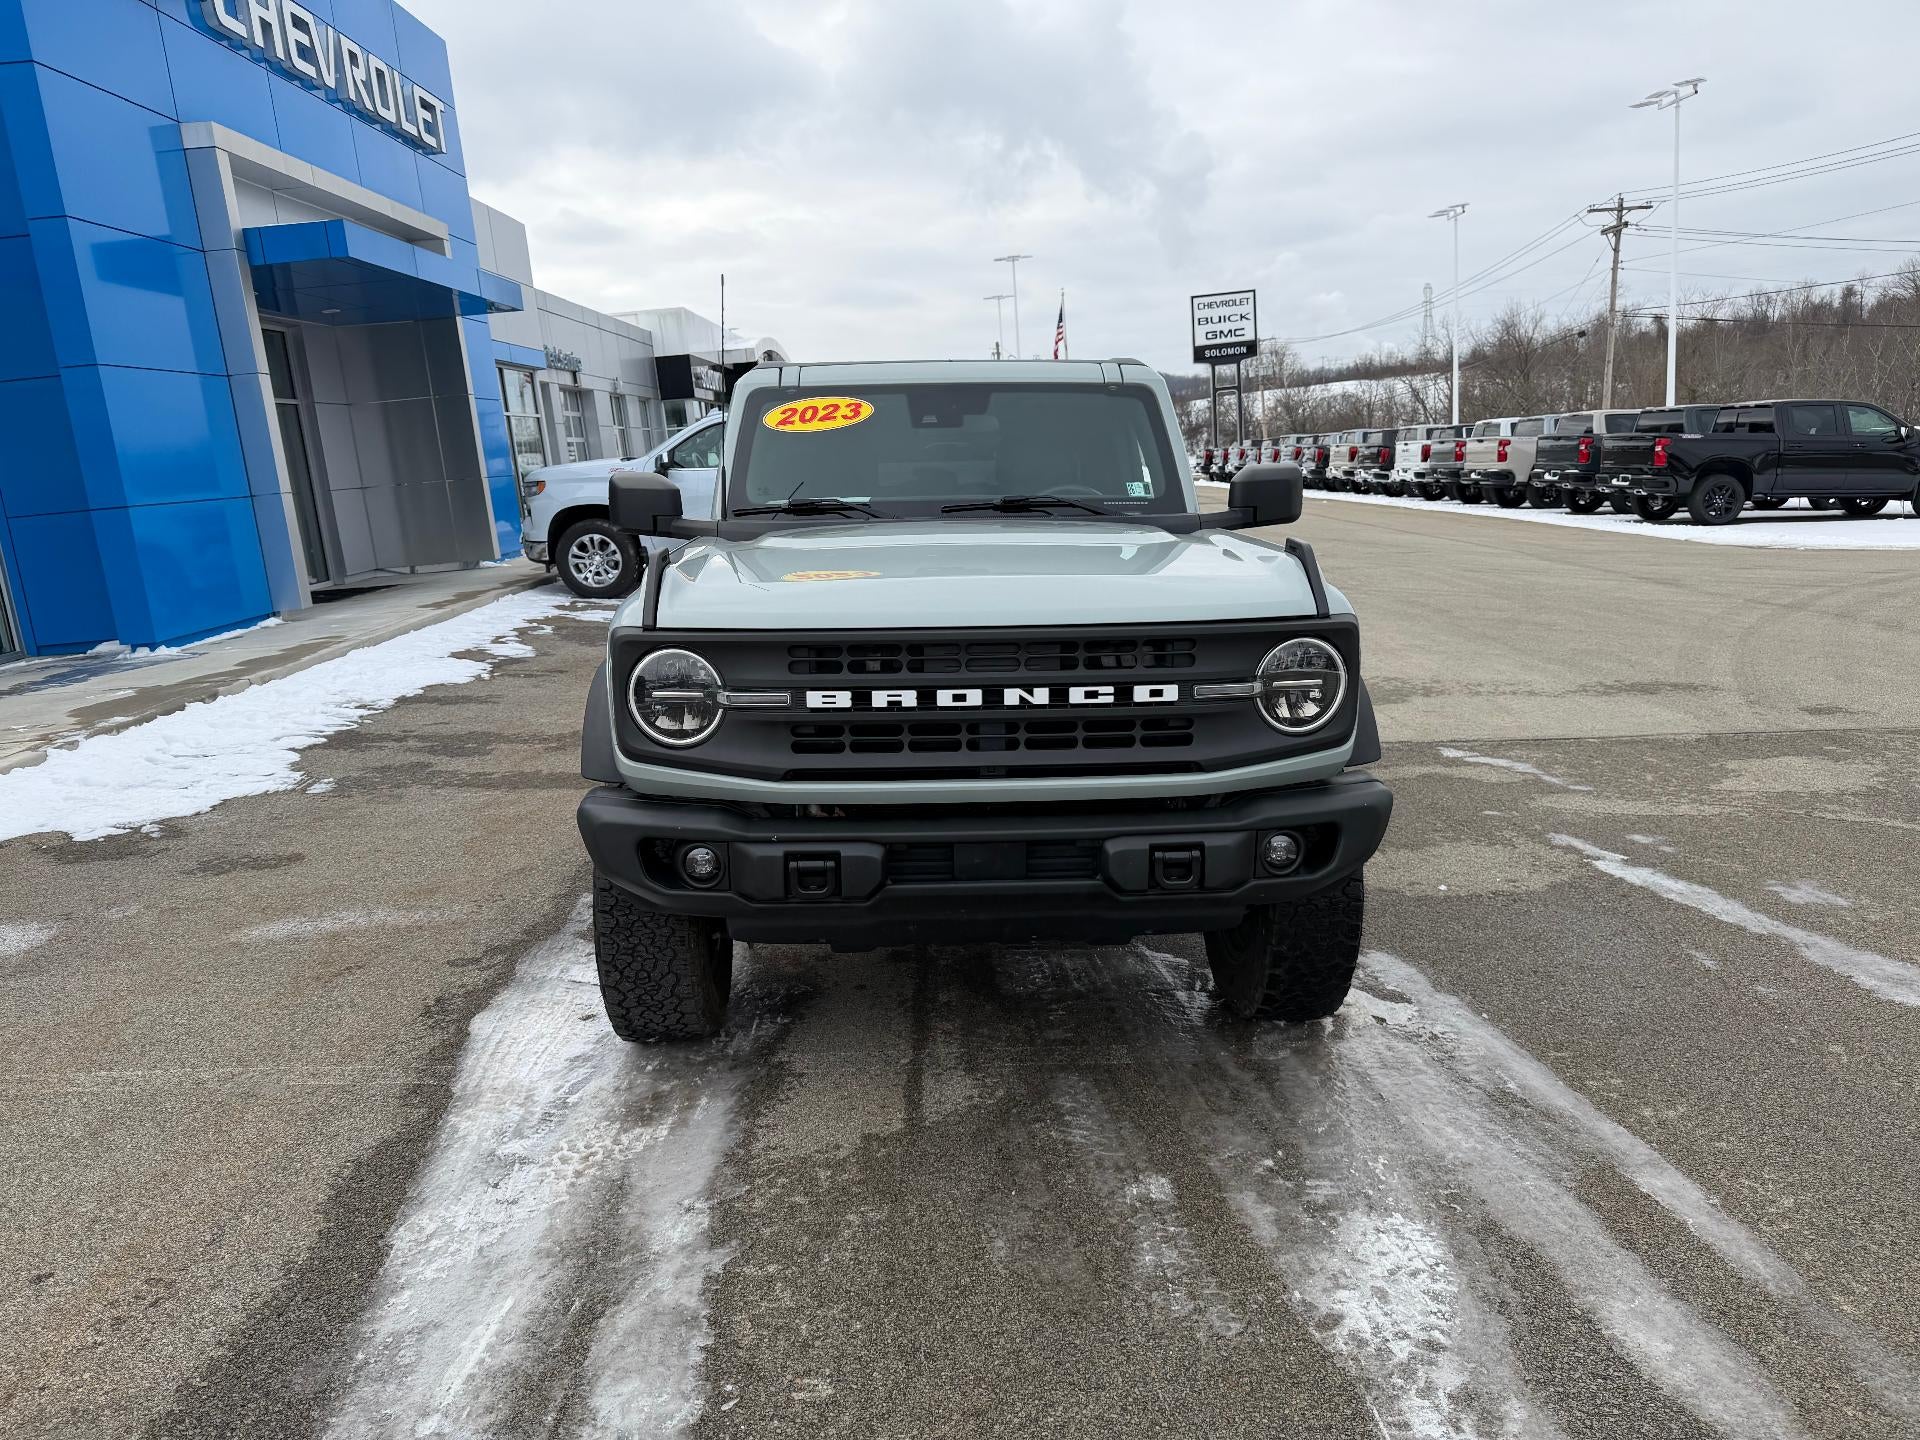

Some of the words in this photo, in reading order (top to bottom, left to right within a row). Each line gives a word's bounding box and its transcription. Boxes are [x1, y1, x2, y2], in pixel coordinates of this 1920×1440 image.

[1197, 297, 1251, 311] CHEVROLET
[1197, 312, 1252, 326] BUICK
[1205, 327, 1246, 341] GMC
[1204, 345, 1248, 358] SOLOMON
[774, 402, 863, 427] 2023
[806, 684, 1178, 708] BRONCO
